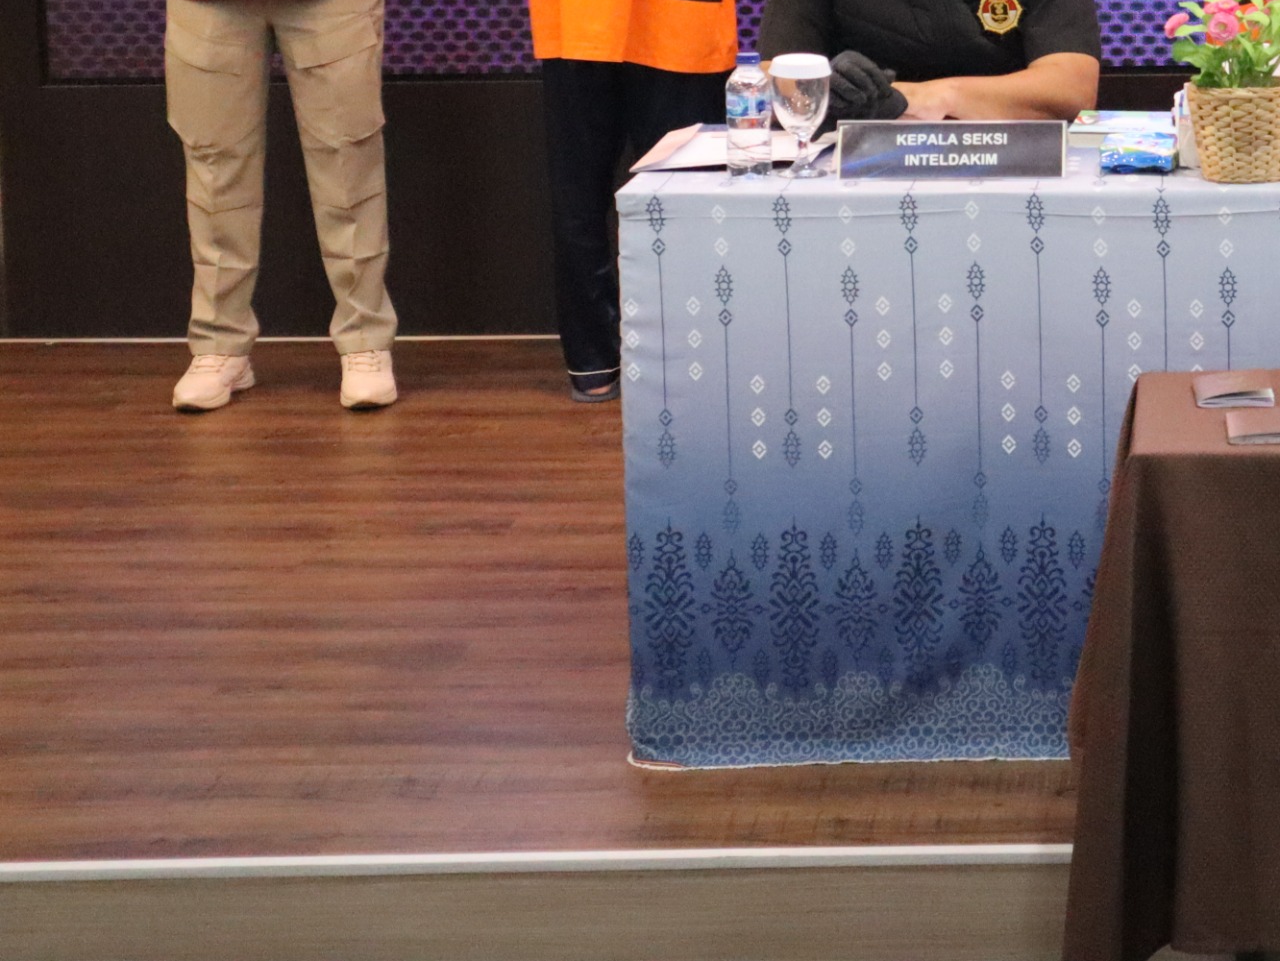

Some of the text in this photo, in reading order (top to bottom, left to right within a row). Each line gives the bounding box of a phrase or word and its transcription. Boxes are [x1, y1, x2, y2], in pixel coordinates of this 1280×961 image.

[896, 131, 1008, 146] KEPALA SEKSI
[904, 152, 998, 167] INTELDAKIM
